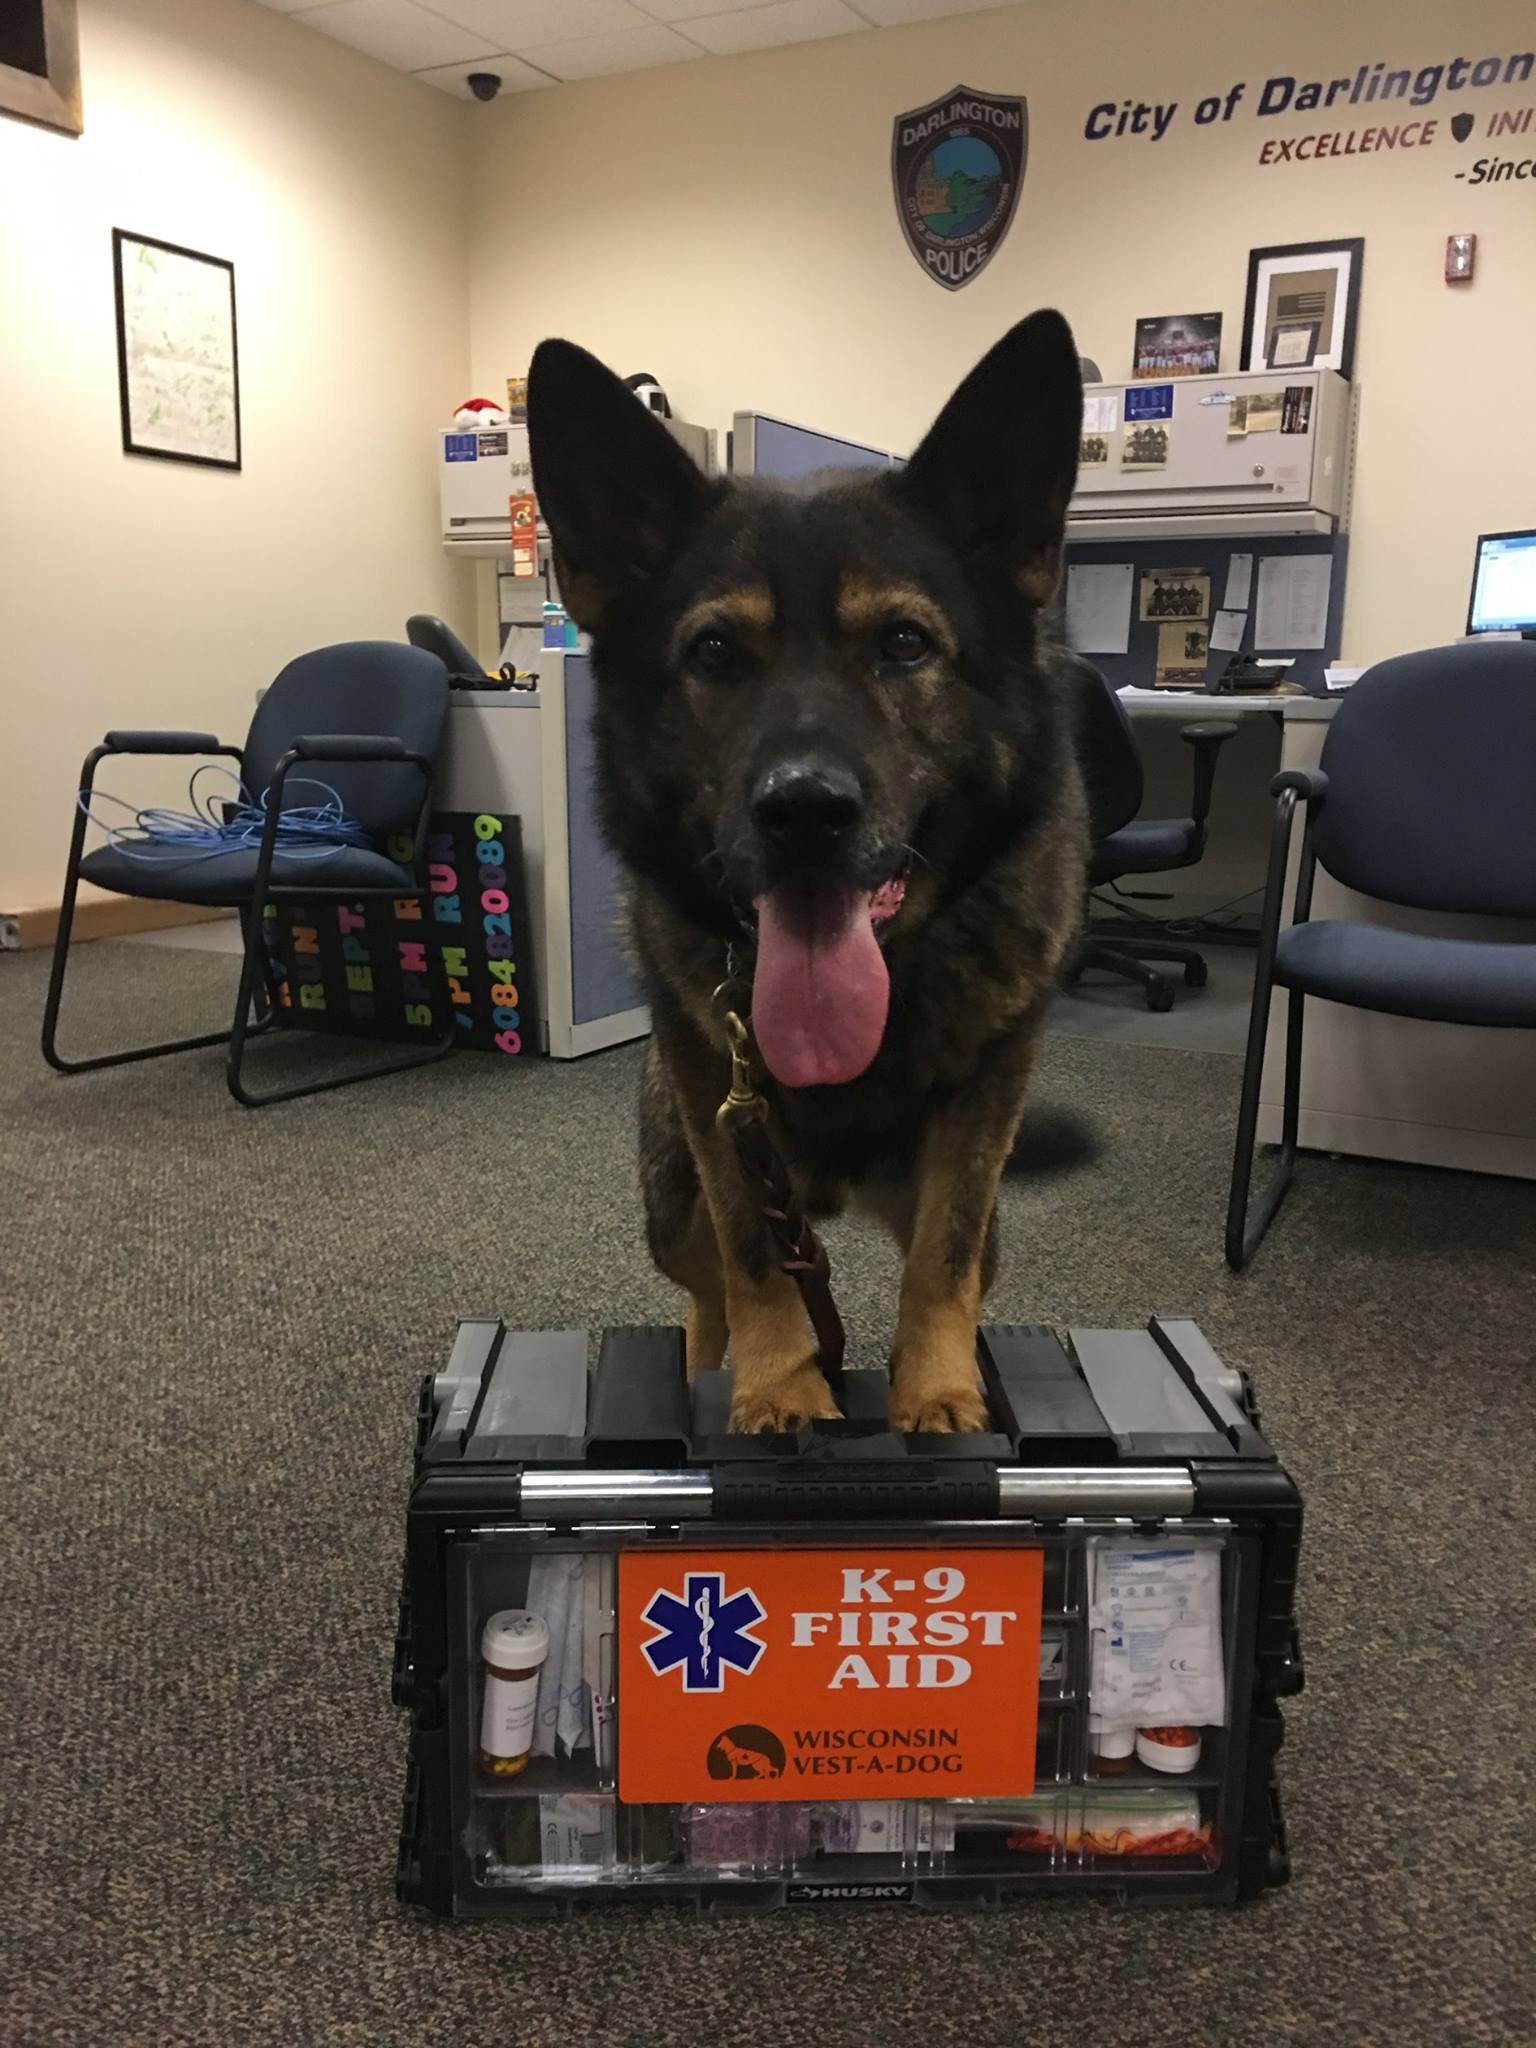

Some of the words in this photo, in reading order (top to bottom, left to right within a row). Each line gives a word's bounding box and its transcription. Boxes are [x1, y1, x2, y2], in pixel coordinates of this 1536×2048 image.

[1084, 100, 1178, 141] City
[1194, 83, 1246, 125] of
[1257, 52, 1535, 117] Darlington
[902, 101, 1020, 147] DARLINGTON
[1258, 120, 1439, 165] EXCELLENCE
[1486, 108, 1536, 138] INI
[926, 241, 989, 280] POLICE
[427, 833, 462, 923] RUN
[473, 814, 522, 1054] 6084820089
[840, 1566, 966, 1604] K-9
[791, 1610, 1017, 1647] FIRST
[827, 1654, 972, 1689] AID
[793, 1728, 959, 1750] WISCONSIN
[792, 1753, 963, 1776] VEST-A-DOG
[822, 1886, 909, 1898] HUSKY
